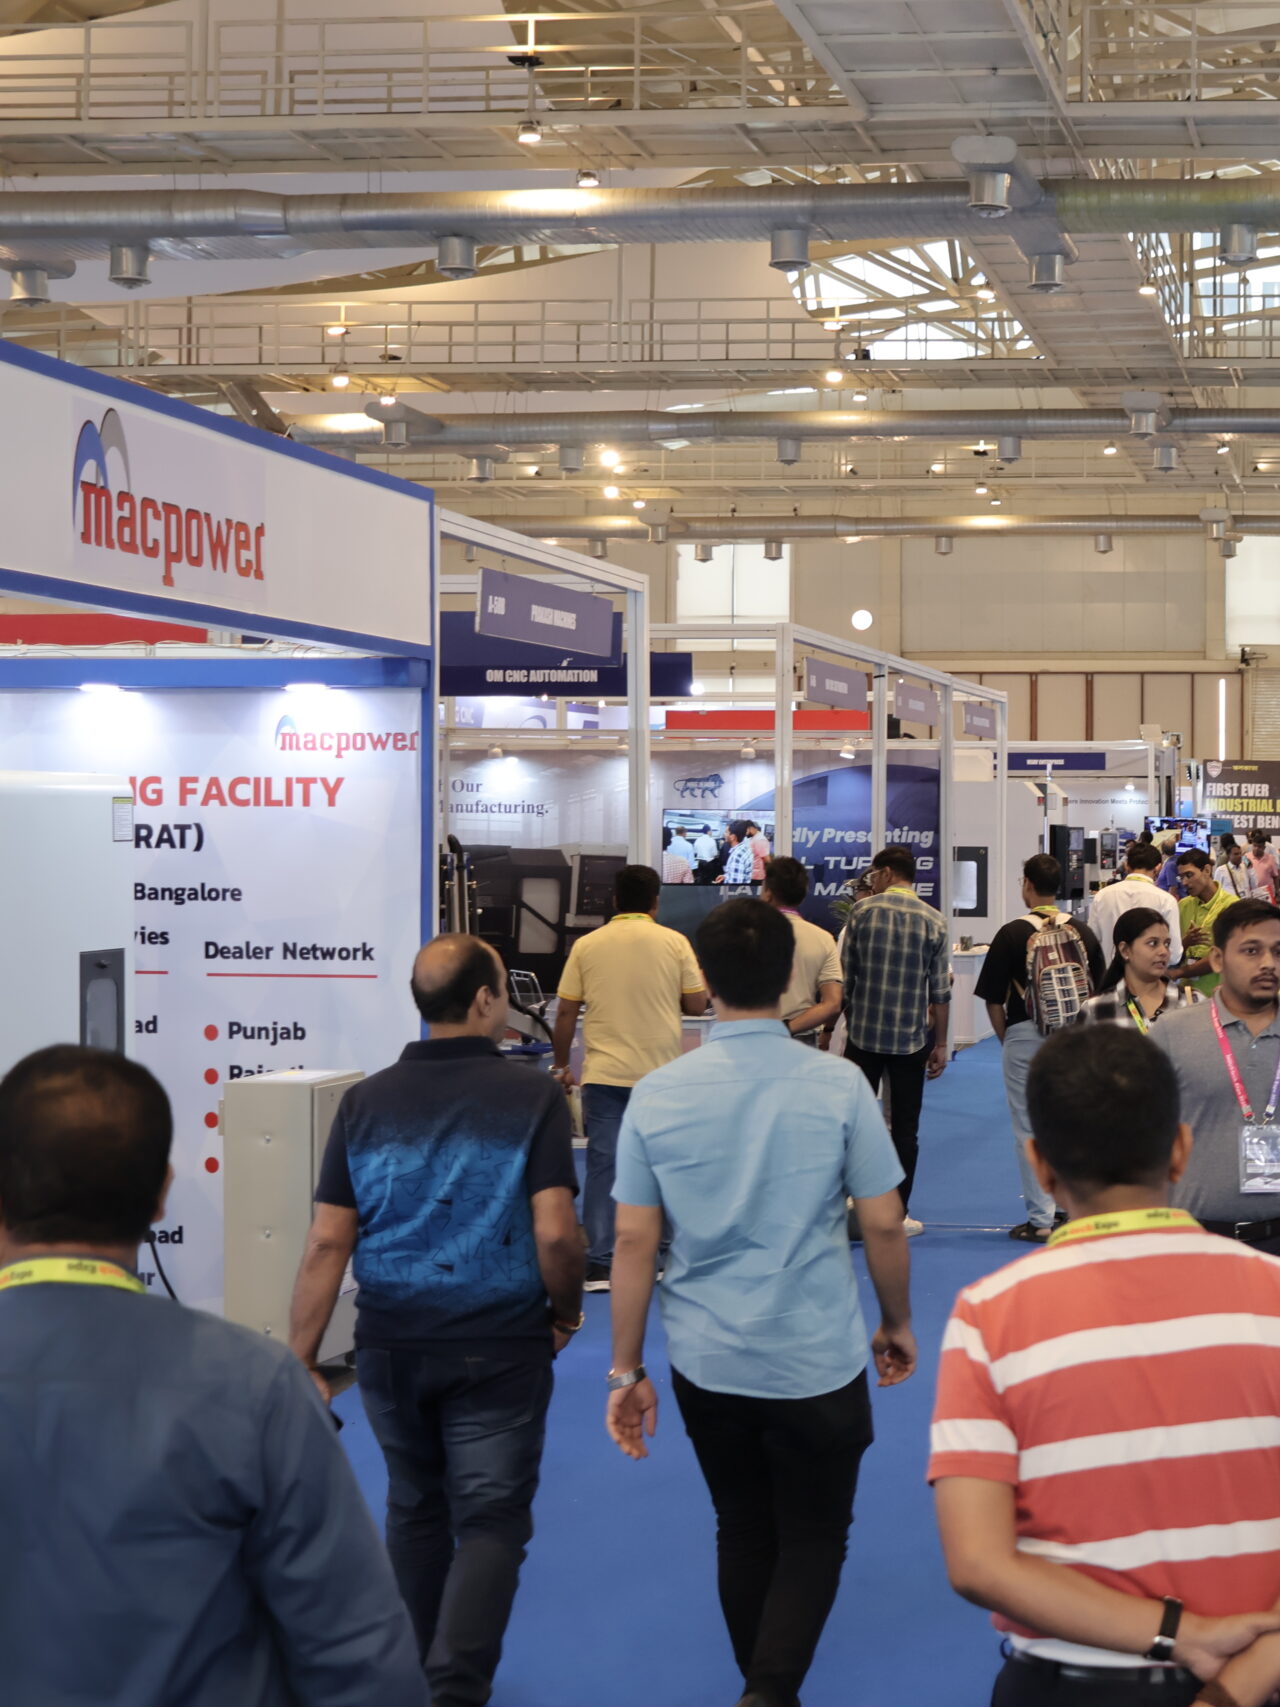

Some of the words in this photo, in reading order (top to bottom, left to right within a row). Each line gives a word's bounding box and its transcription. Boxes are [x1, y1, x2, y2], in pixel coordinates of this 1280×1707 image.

[80, 480, 265, 587] macpower
[486, 669, 503, 682] OM
[505, 669, 528, 682] CNC
[529, 669, 598, 682] AUTOMATION
[280, 730, 420, 759] macpower
[178, 776, 345, 807] FACILITY
[451, 778, 483, 793] Our
[1206, 783, 1239, 797] FIRST
[1241, 783, 1269, 797] EVER
[1206, 799, 1274, 813] INDUSTRIAL
[134, 882, 242, 906] Bangalore
[205, 941, 273, 960] Dealer
[282, 942, 375, 961] Network
[228, 1021, 306, 1046] Punjab
